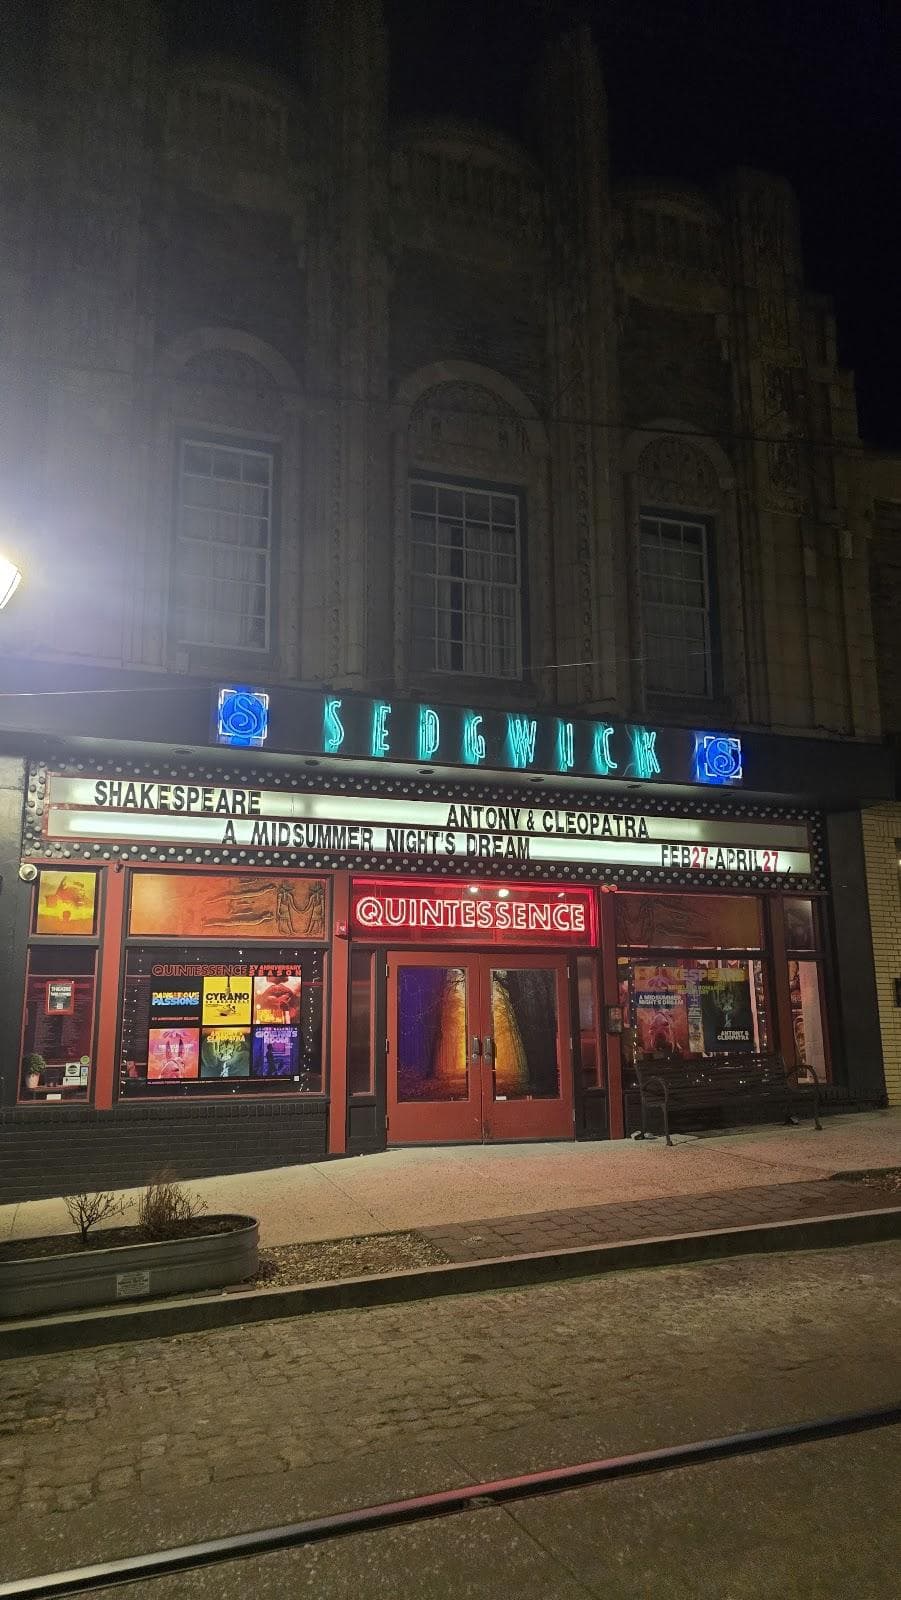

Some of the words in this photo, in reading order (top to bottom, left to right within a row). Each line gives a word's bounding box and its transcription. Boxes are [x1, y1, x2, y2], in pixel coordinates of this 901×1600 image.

[325, 698, 661, 776] SEDGWICK
[94, 780, 261, 816] SHAKESPEARE
[221, 819, 237, 845] A
[250, 820, 374, 852] MIDSUMMER
[386, 827, 456, 856] NIGHT'S
[465, 833, 531, 861] DREAM
[446, 804, 521, 830] ANTONY
[526, 809, 536, 832] &
[542, 810, 650, 840] CLEOPATRA
[356, 896, 586, 932] QUINTESSENCE
[152, 964, 247, 977] QUINTESSENCE
[205, 992, 249, 1001] CYRANO
